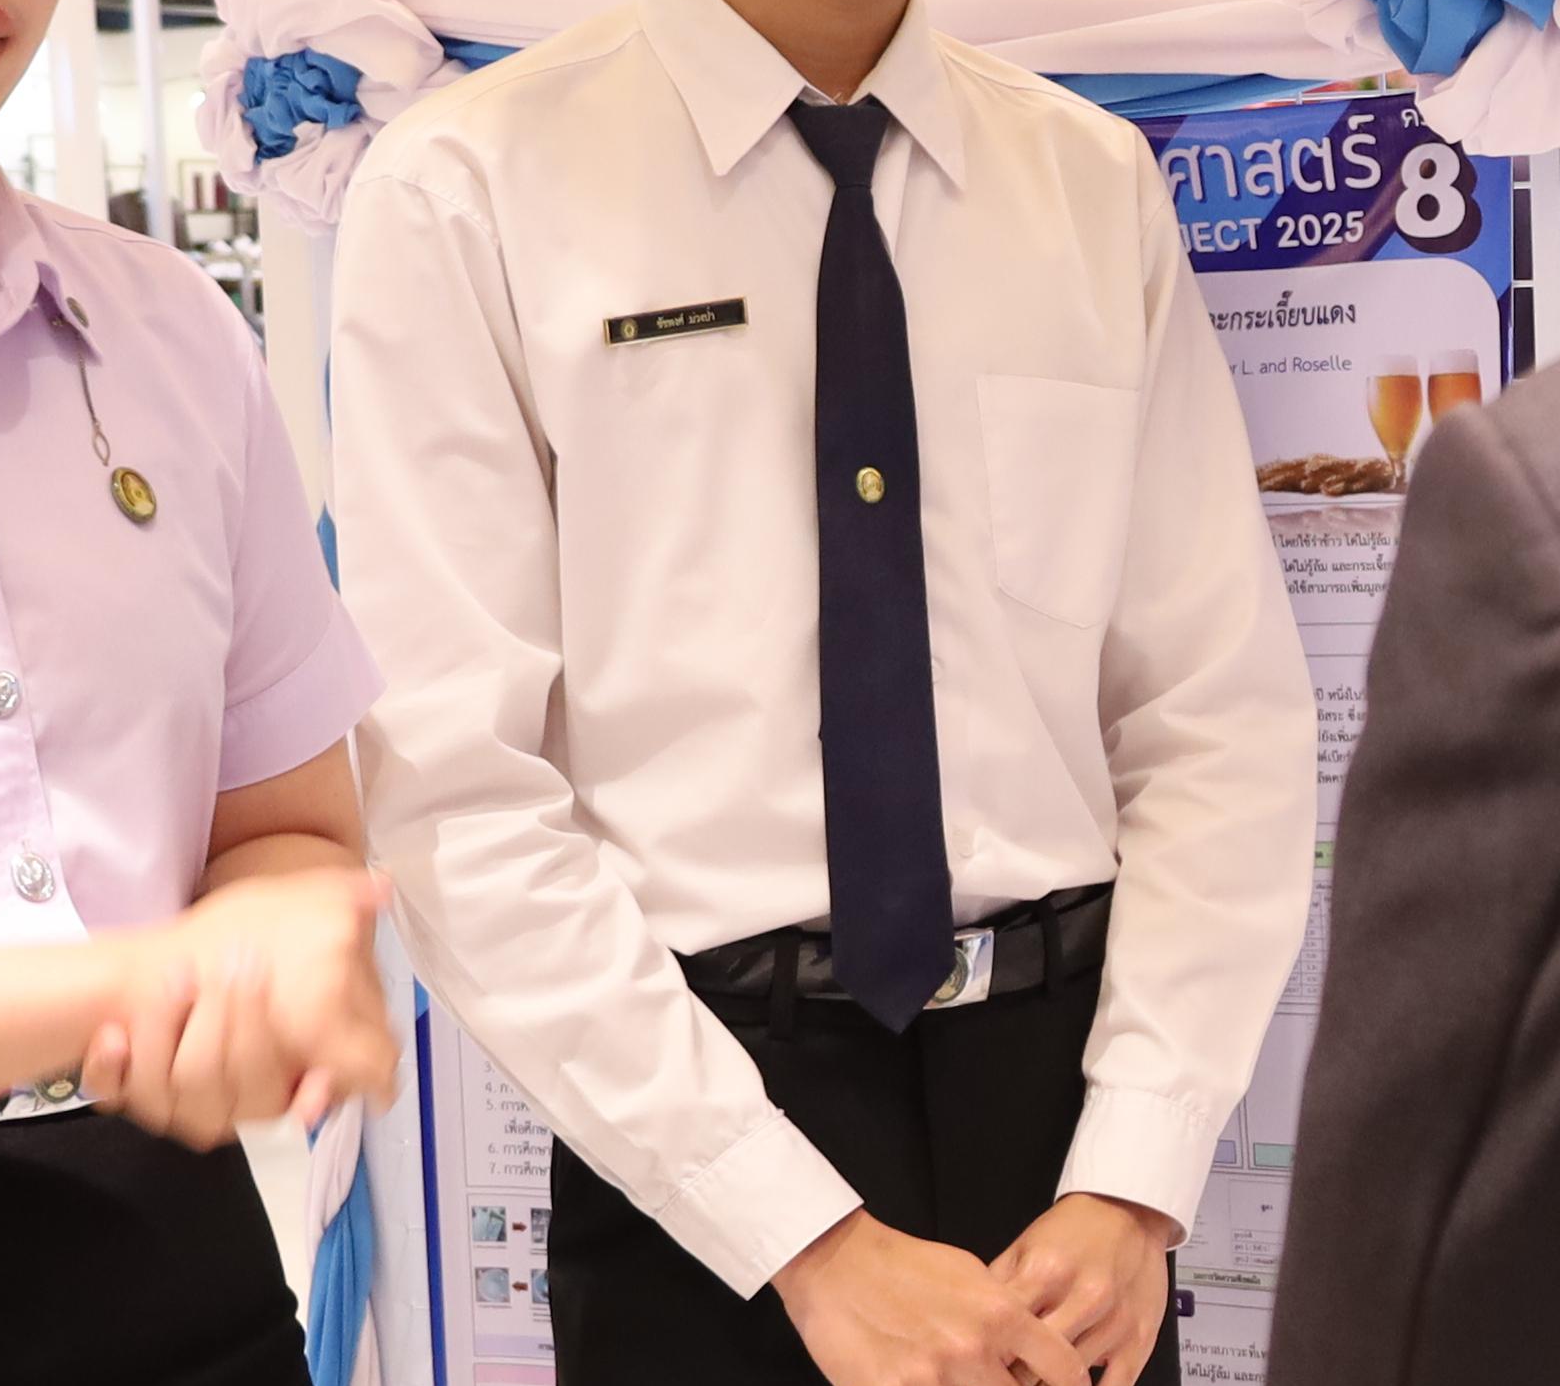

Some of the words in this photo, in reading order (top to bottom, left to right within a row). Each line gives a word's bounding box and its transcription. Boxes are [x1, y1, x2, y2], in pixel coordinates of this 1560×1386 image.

[1395, 142, 1466, 239] 8
[1276, 211, 1365, 249] 2025
[1260, 357, 1287, 374] and
[1293, 355, 1352, 373] Roselle
